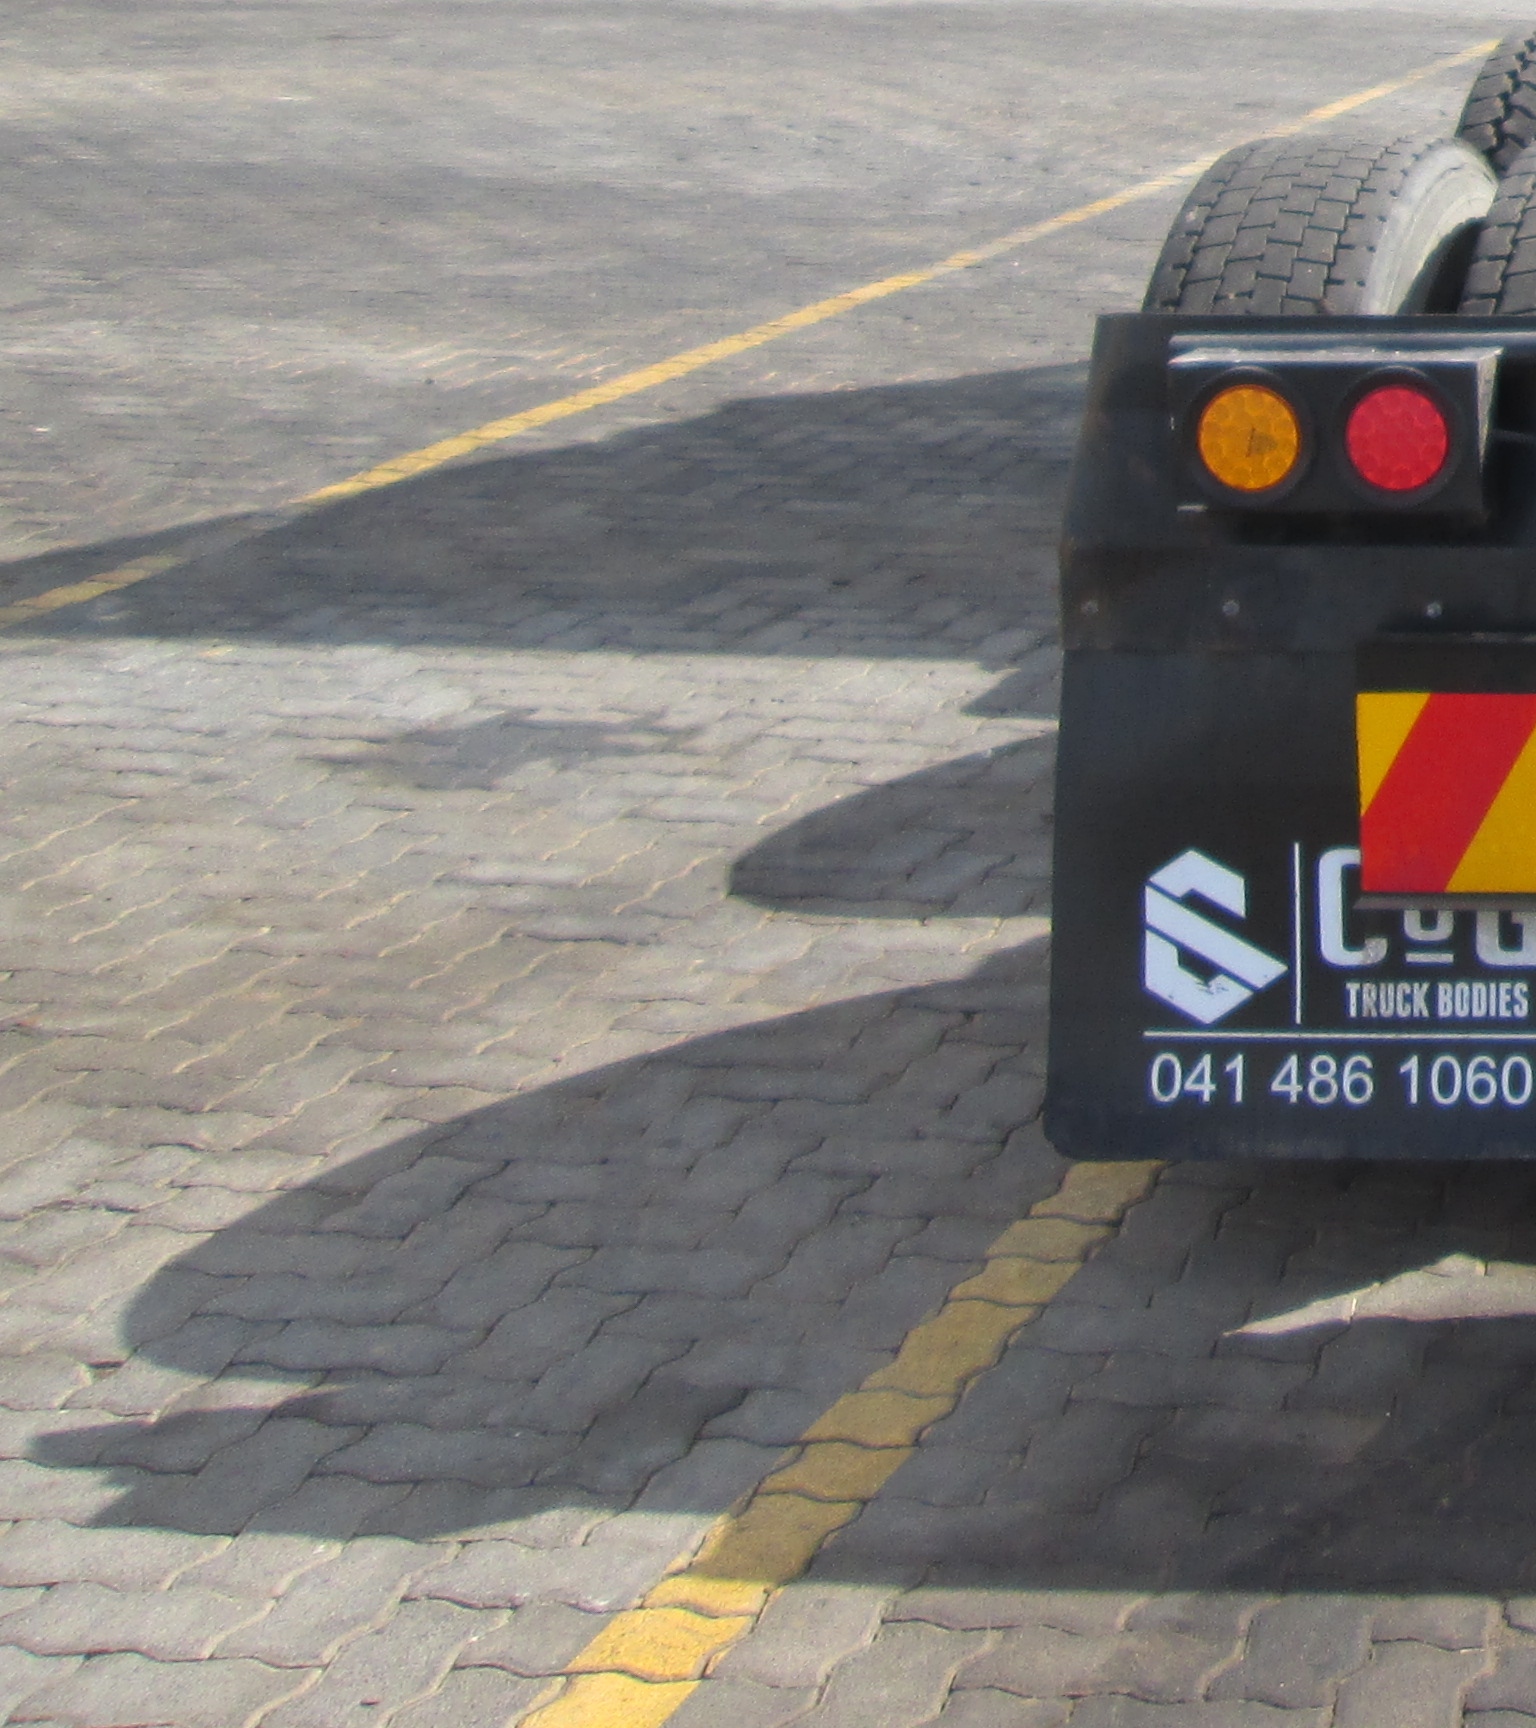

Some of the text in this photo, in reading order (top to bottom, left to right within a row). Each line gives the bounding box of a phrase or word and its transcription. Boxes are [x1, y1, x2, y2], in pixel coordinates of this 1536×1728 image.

[1345, 981, 1529, 1018] TRUCK BODIES
[1150, 1052, 1533, 1106] 041 486 1060
